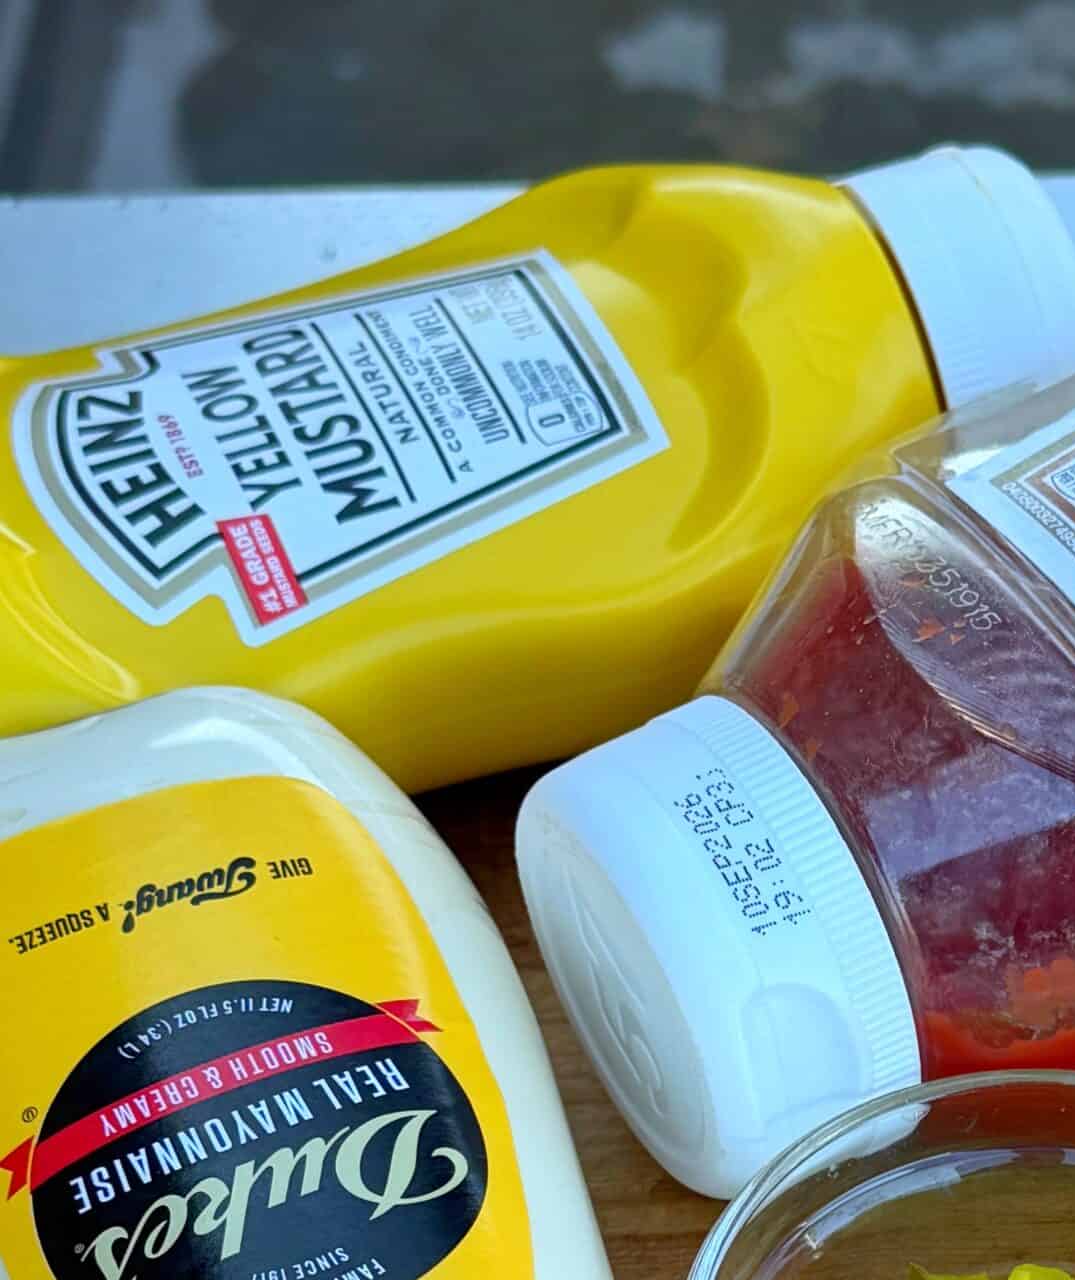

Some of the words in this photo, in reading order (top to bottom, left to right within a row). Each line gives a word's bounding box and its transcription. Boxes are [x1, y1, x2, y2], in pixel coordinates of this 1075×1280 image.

[409, 305, 448, 341] WELL
[349, 341, 420, 444] NATURAL
[419, 357, 451, 396] DONE
[432, 342, 510, 445] UNCOMMONLY
[158, 415, 184, 444] 1869
[181, 365, 302, 511] YELLOW
[243, 328, 402, 525] MUSTARD
[414, 381, 463, 453] COMMON
[77, 390, 206, 548] HEINZ
[459, 460, 474, 472] A
[229, 523, 269, 585] GRADE
[250, 519, 274, 554] SEEDS
[259, 588, 284, 612] #1
[267, 556, 298, 608] MUSTARD
[267, 857, 313, 879] GIVE
[673, 793, 778, 936] 10SEP2026
[96, 902, 110, 922] A
[121, 856, 256, 934] Twang!
[8, 909, 95, 955] SQUEEZE.
[174, 1009, 197, 1029] OZ
[202, 1004, 219, 1020] FL
[223, 998, 254, 1014] 11.5
[260, 997, 293, 1014] NET
[202, 1069, 224, 1089] &
[231, 1031, 334, 1081] SMOOTH
[312, 1057, 410, 1110] REAL
[100, 1078, 200, 1137] CREAMY
[69, 1087, 314, 1215] MAYONNAISE
[292, 1247, 350, 1280] SINCE
